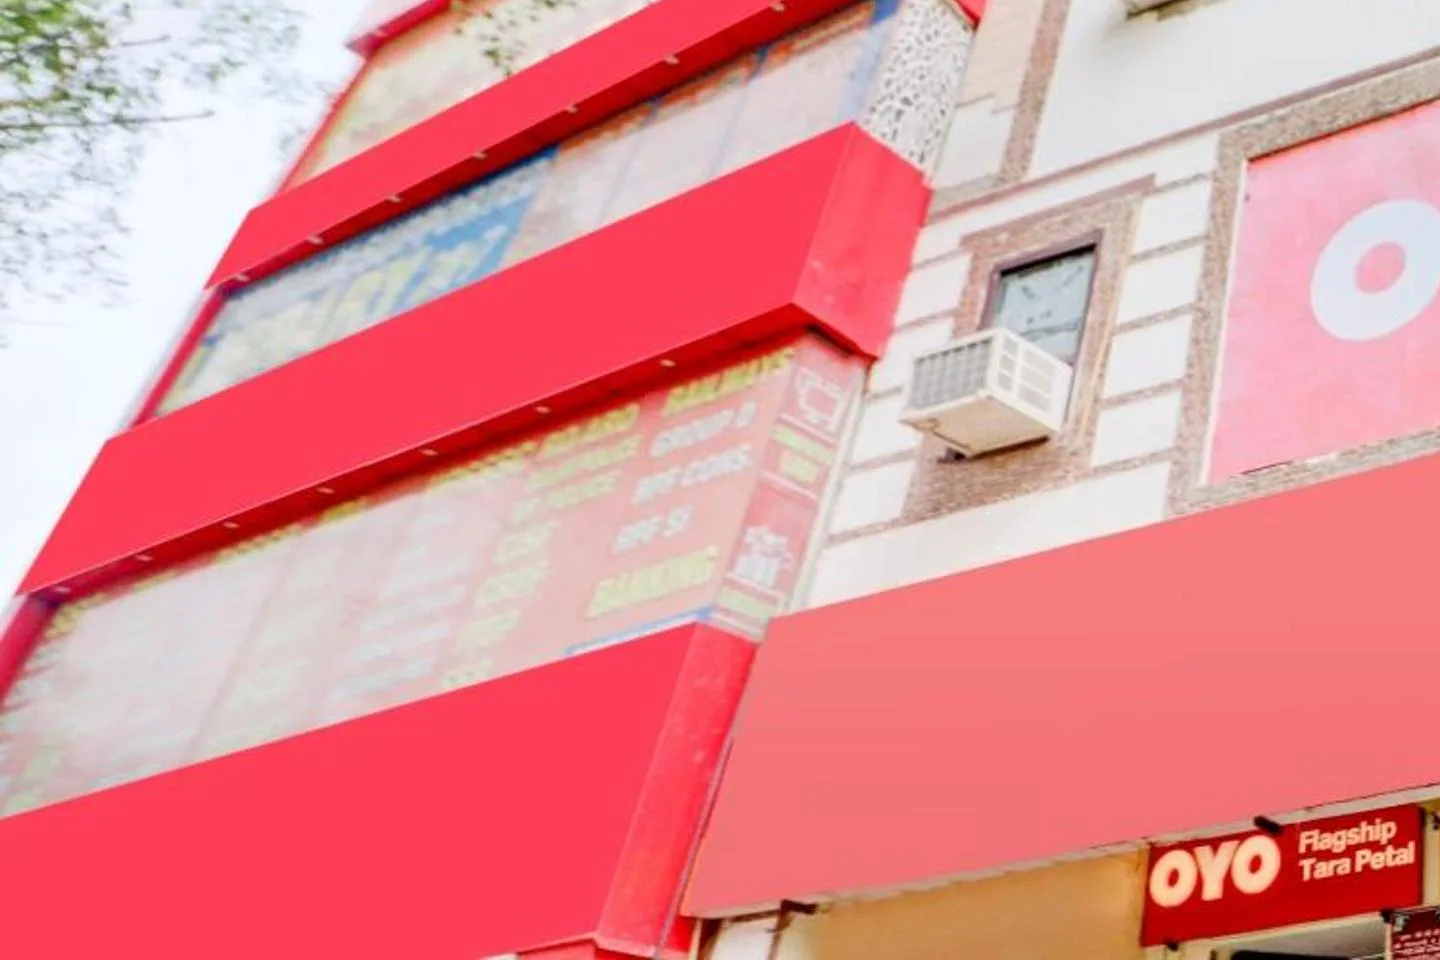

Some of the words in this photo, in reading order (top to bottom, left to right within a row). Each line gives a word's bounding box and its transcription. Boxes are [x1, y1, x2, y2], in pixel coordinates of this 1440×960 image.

[1298, 818, 1397, 853] Flagship
[1149, 835, 1281, 908] OYO
[1299, 857, 1352, 881] Tara
[1355, 841, 1416, 873] Petal
